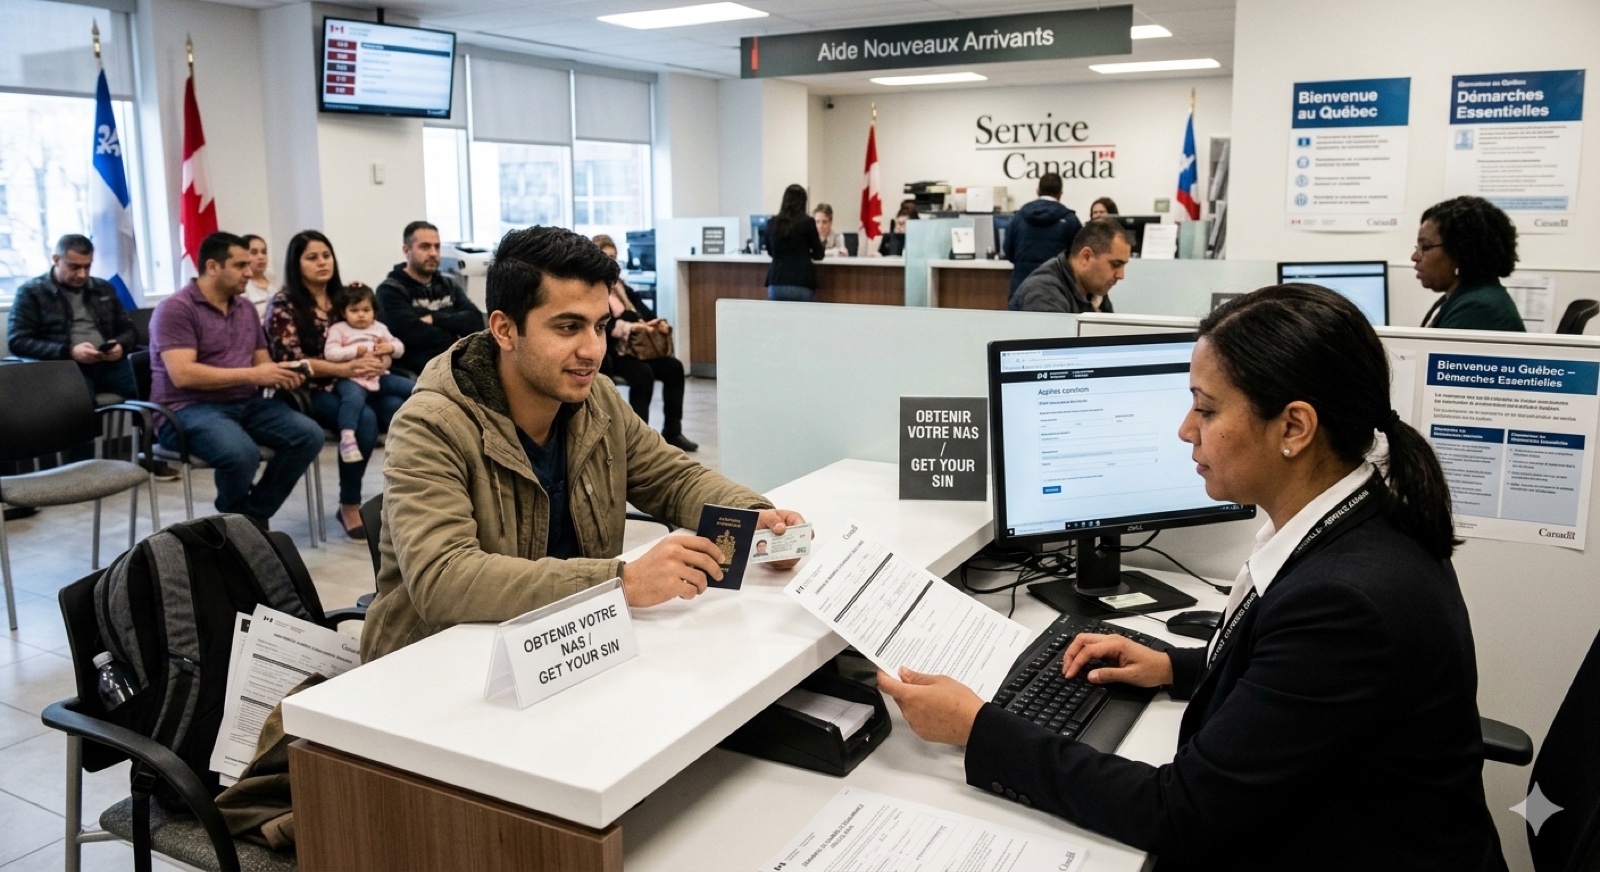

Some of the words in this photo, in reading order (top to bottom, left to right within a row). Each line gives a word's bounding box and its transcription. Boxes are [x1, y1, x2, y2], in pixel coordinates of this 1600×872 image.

[817, 40, 858, 61] Aide
[863, 33, 959, 59] Nouveaux
[963, 26, 1055, 52] Arrivants
[1298, 91, 1378, 104] Bienvenue
[1297, 109, 1316, 119] au
[1319, 105, 1378, 120] Québec
[975, 112, 1088, 144] Service
[1003, 151, 1115, 180] Canada
[1437, 360, 1498, 373] Bienvenue
[1501, 364, 1516, 374] au
[916, 409, 972, 424] OBTENIR
[907, 425, 950, 439] VOTRE
[952, 425, 979, 440] NAS
[940, 441, 947, 457] /
[911, 458, 936, 472] GET
[939, 458, 975, 472] YOUR
[931, 474, 954, 488] SIN
[523, 621, 577, 654] OBTENIR
[579, 605, 617, 630] VOTRE
[561, 636, 585, 656] NAS
[538, 663, 563, 685] GET
[565, 650, 599, 672] YOUR
[602, 639, 620, 657] SIN
